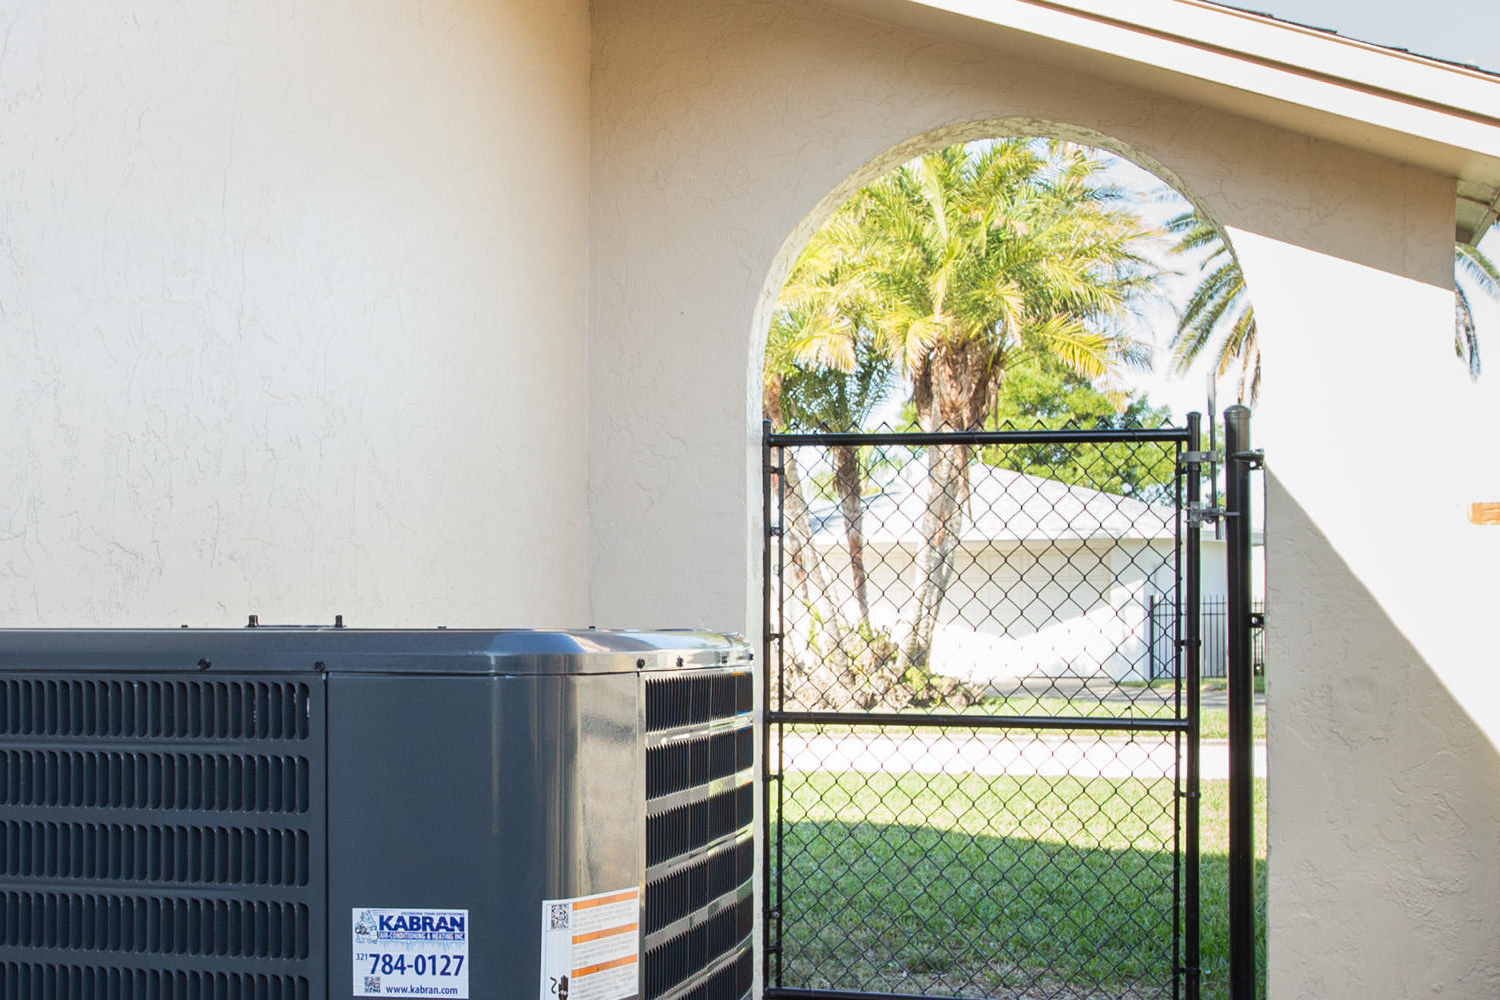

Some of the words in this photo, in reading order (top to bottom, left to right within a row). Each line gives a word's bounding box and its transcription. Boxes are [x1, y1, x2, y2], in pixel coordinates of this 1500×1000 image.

[379, 915, 465, 932] KABRAN
[369, 953, 464, 976] 784-0127
[386, 985, 458, 995] www.kabran.com
